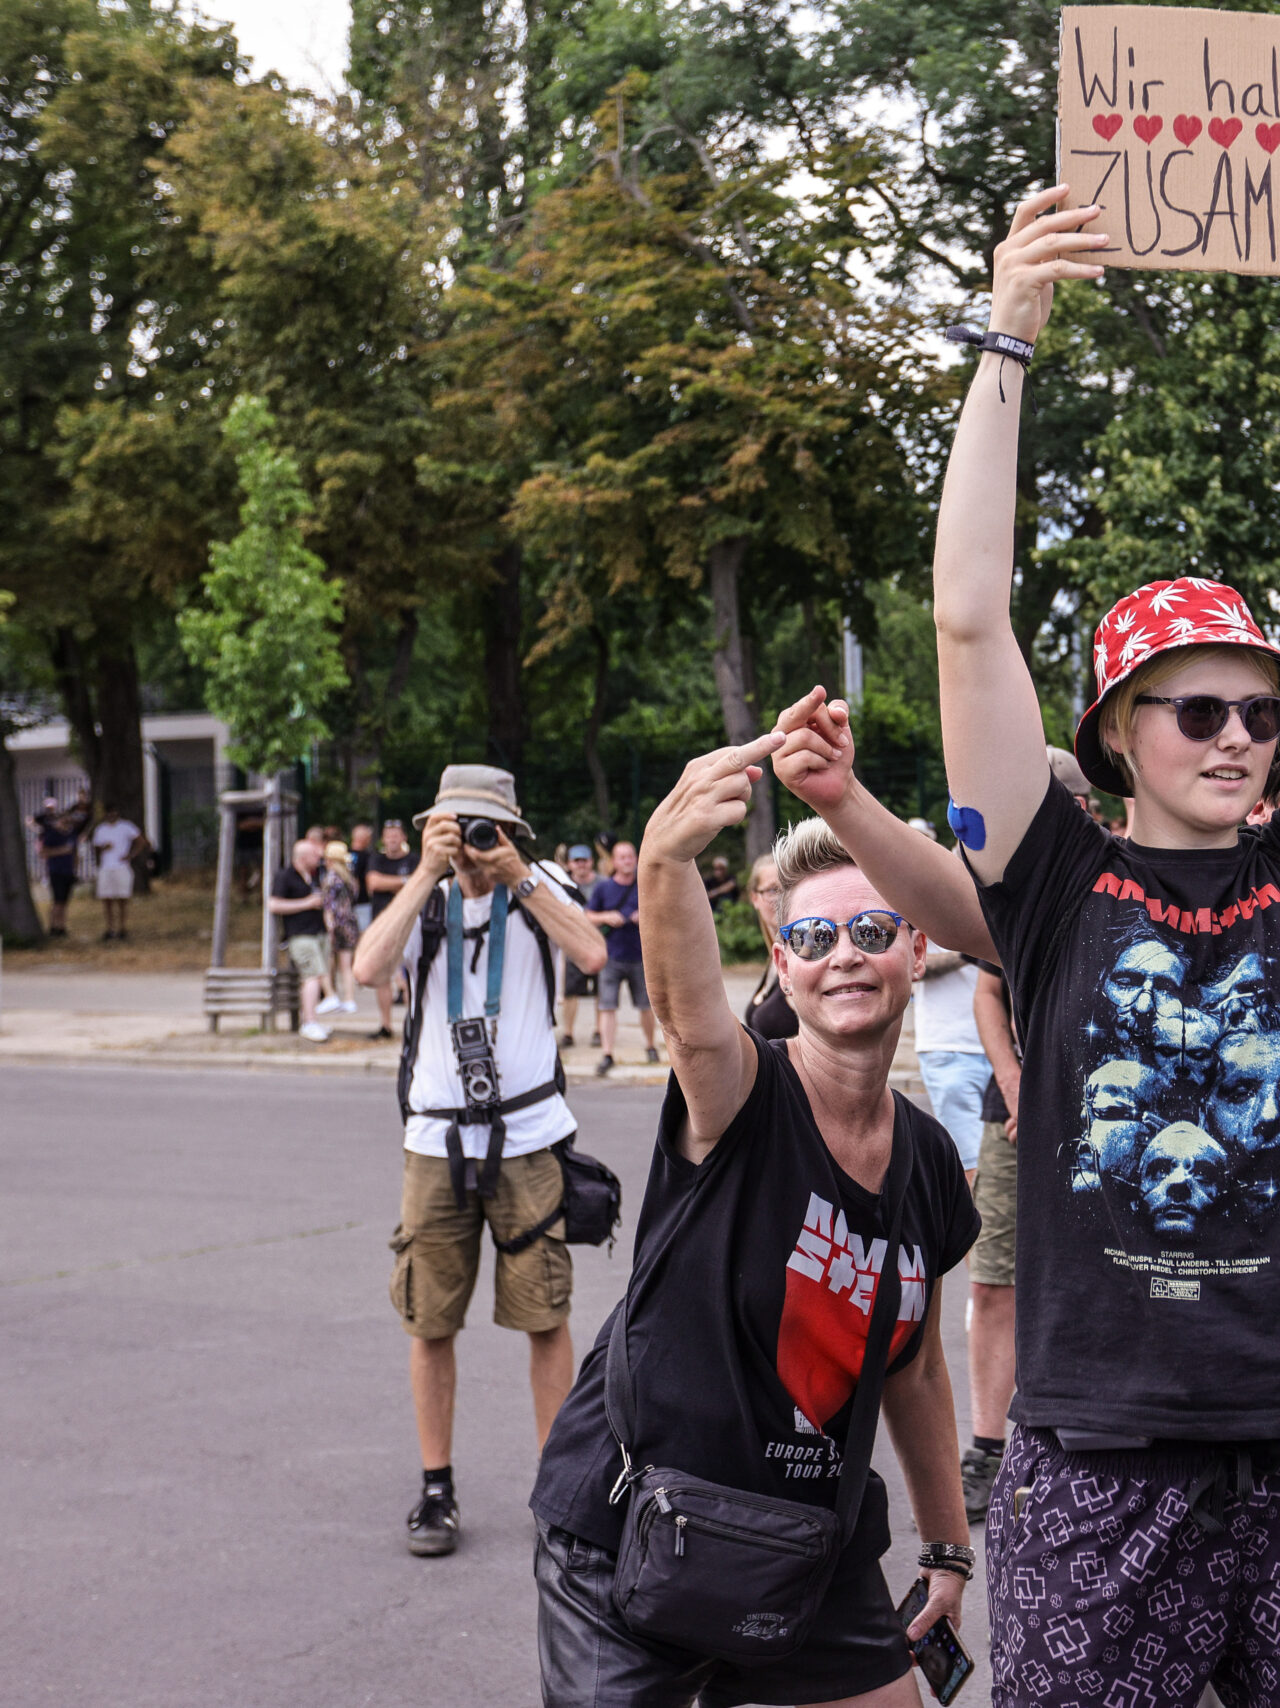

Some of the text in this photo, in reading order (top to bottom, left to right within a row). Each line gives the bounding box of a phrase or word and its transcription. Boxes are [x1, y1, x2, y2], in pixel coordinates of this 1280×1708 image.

[1075, 26, 1164, 112] Wir
[1157, 1258, 1175, 1267] PAUL
[1176, 1259, 1210, 1268] LANDERS
[1215, 1259, 1231, 1267] TILL
[1231, 1256, 1271, 1267] LINDEMANN
[1160, 1250, 1195, 1260] STARRING
[786, 1228, 926, 1322] STEN
[1150, 1264, 1174, 1275] RIEDEL
[1177, 1267, 1219, 1276] CHRISTOPH
[1219, 1265, 1259, 1275] SCHNEIDER
[765, 1441, 824, 1462] EUROPE
[785, 1463, 823, 1479] TOUR
